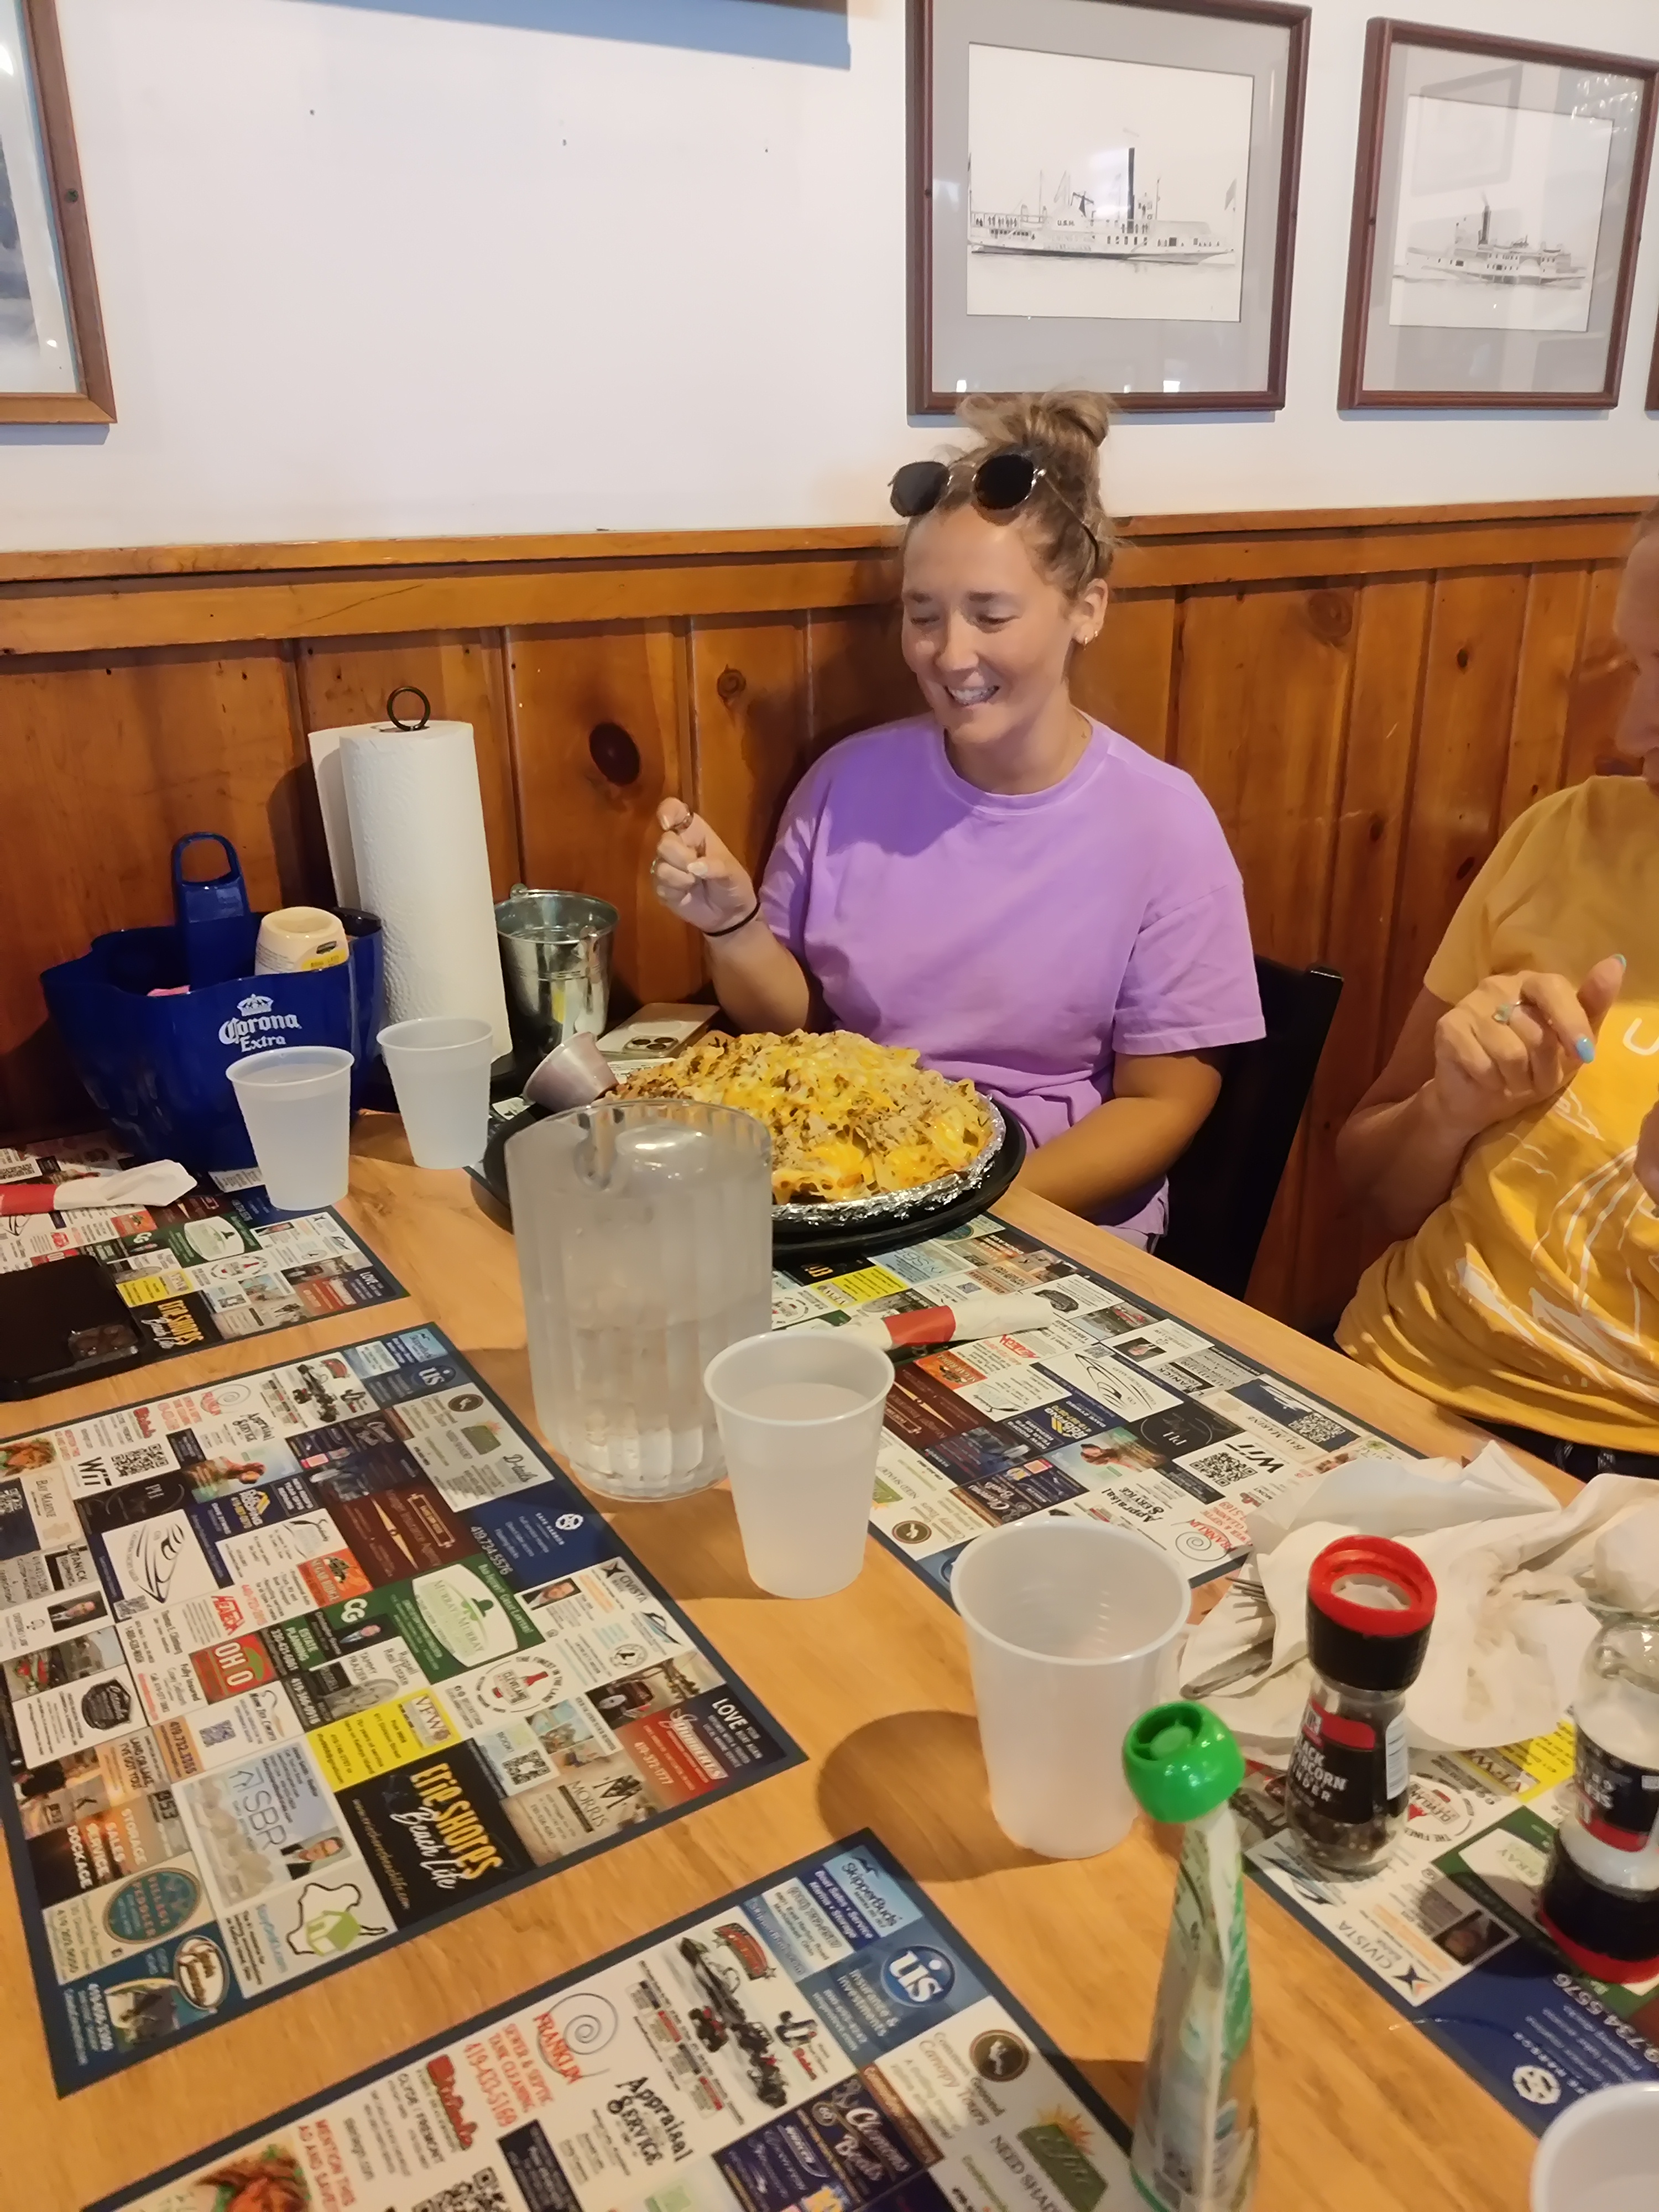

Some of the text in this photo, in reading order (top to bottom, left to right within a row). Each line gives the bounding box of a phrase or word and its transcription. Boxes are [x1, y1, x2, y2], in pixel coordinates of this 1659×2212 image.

[218, 1014, 299, 1045] Corona
[241, 1035, 286, 1052] Extra
[966, 1241, 1000, 1260] STORAGE
[978, 1241, 1004, 1256] SALES
[988, 1234, 1025, 1255] DOCKAGE
[357, 1270, 380, 1285] LOVE
[820, 1287, 849, 1305] VFW
[934, 1353, 978, 1382] SUGAR RIDGE
[1155, 1366, 1205, 1396] LATANICK
[1201, 1354, 1241, 1377] FABRICATION
[1005, 1420, 1048, 1449] NEW ROOFS
[1013, 1419, 1053, 1446] TEAR OFFS
[1023, 1420, 1056, 1441] REPAIRS
[1041, 1407, 1089, 1437] ROOFING
[1087, 1415, 1108, 1428] DAVE
[1160, 1430, 1189, 1446] PH
[1243, 1414, 1306, 1451] BAY MARINE
[34, 1478, 58, 1520] BAY MARINE
[898, 1484, 920, 1499] NEED
[1096, 1485, 1164, 1527] Appraisal
[1117, 1485, 1166, 1516] SERVICE
[1185, 1517, 1239, 1553] FRANKLIN
[1200, 1510, 1225, 1526] SEPTIC
[1209, 1506, 1245, 1529] CLEANING
[467, 1525, 515, 1577] 419.734.5576
[617, 1574, 649, 1604] CIVISTA
[284, 1626, 310, 1662] PLANNING
[296, 1627, 318, 1653] ESTATE
[346, 1654, 369, 1683] FRAZIER
[357, 1651, 378, 1676] TAMMY
[177, 1662, 202, 1703] Fully Insured
[500, 1671, 528, 1702] CLEVELAND
[413, 1694, 446, 1733] VFW
[709, 1697, 749, 1731] LOVE
[1468, 1750, 1527, 1792] VFW
[239, 1787, 290, 1853] SBR
[566, 1778, 610, 1829] MORRIS
[85, 1821, 110, 1879] SERVICE
[104, 1820, 126, 1864] SALES
[120, 1806, 147, 1867] STORAGE
[388, 1798, 470, 1897] Beach Life
[65, 1823, 92, 1891] DOCKAGE
[131, 1879, 156, 1939] PEDDLER
[807, 1880, 859, 1940] Marina Storage
[827, 1886, 850, 1908] Sales
[846, 1910, 875, 1940] Service
[1334, 1918, 1397, 1971] CIVISTA
[1371, 1936, 1404, 1962] BANK
[835, 1975, 889, 2038] Investments
[848, 1968, 900, 2028] Insurance &
[1558, 2002, 1598, 2033] docks
[503, 2022, 529, 2059] SEWER
[525, 2067, 554, 2107] SEPTIC
[531, 2010, 584, 2086] FRANKLIN
[1512, 2030, 1570, 2078] HARBOR
[462, 2039, 519, 2130] 419-433-5169
[486, 2032, 535, 2115] TANK CLEANING
[912, 2037, 994, 2129] Canopy Tours
[931, 2029, 1008, 2119] Common Ground
[604, 2091, 665, 2171] SERVICE
[614, 2066, 700, 2171] Appraisal
[844, 2100, 916, 2182] Clemons
[988, 2133, 1027, 2177] NEED
